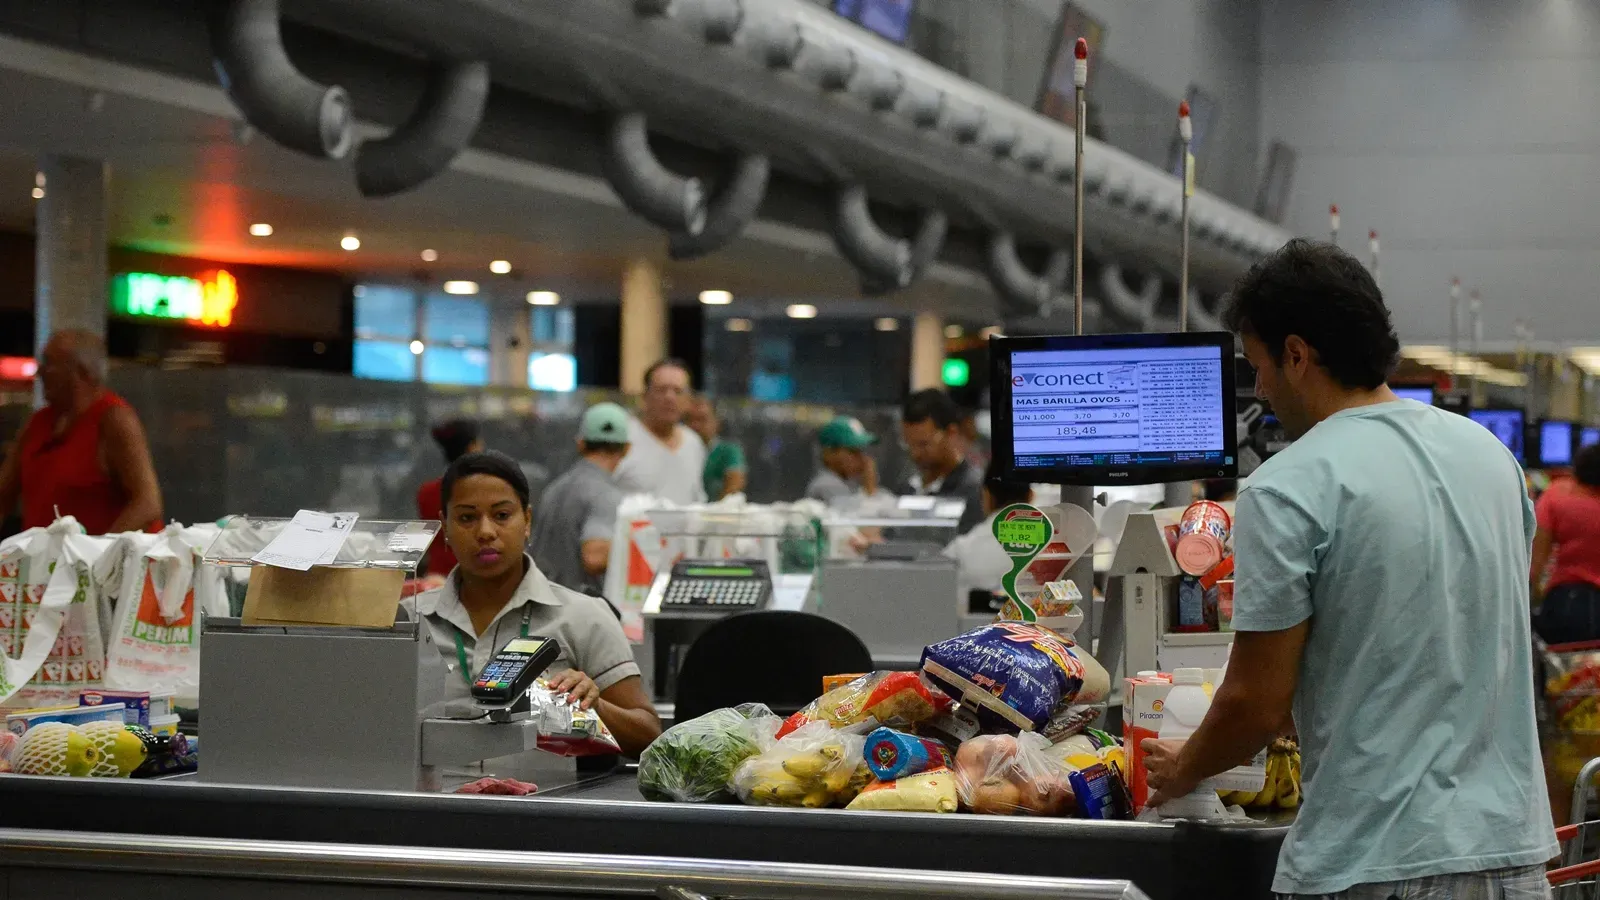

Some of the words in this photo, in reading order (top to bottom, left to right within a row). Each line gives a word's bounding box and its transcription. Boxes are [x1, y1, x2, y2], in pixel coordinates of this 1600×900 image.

[1034, 371, 1104, 387] conect
[1016, 398, 1040, 406] MAS
[1043, 396, 1087, 405] BARILLA
[1090, 395, 1121, 404] OVOS
[1056, 426, 1097, 436] 185,48
